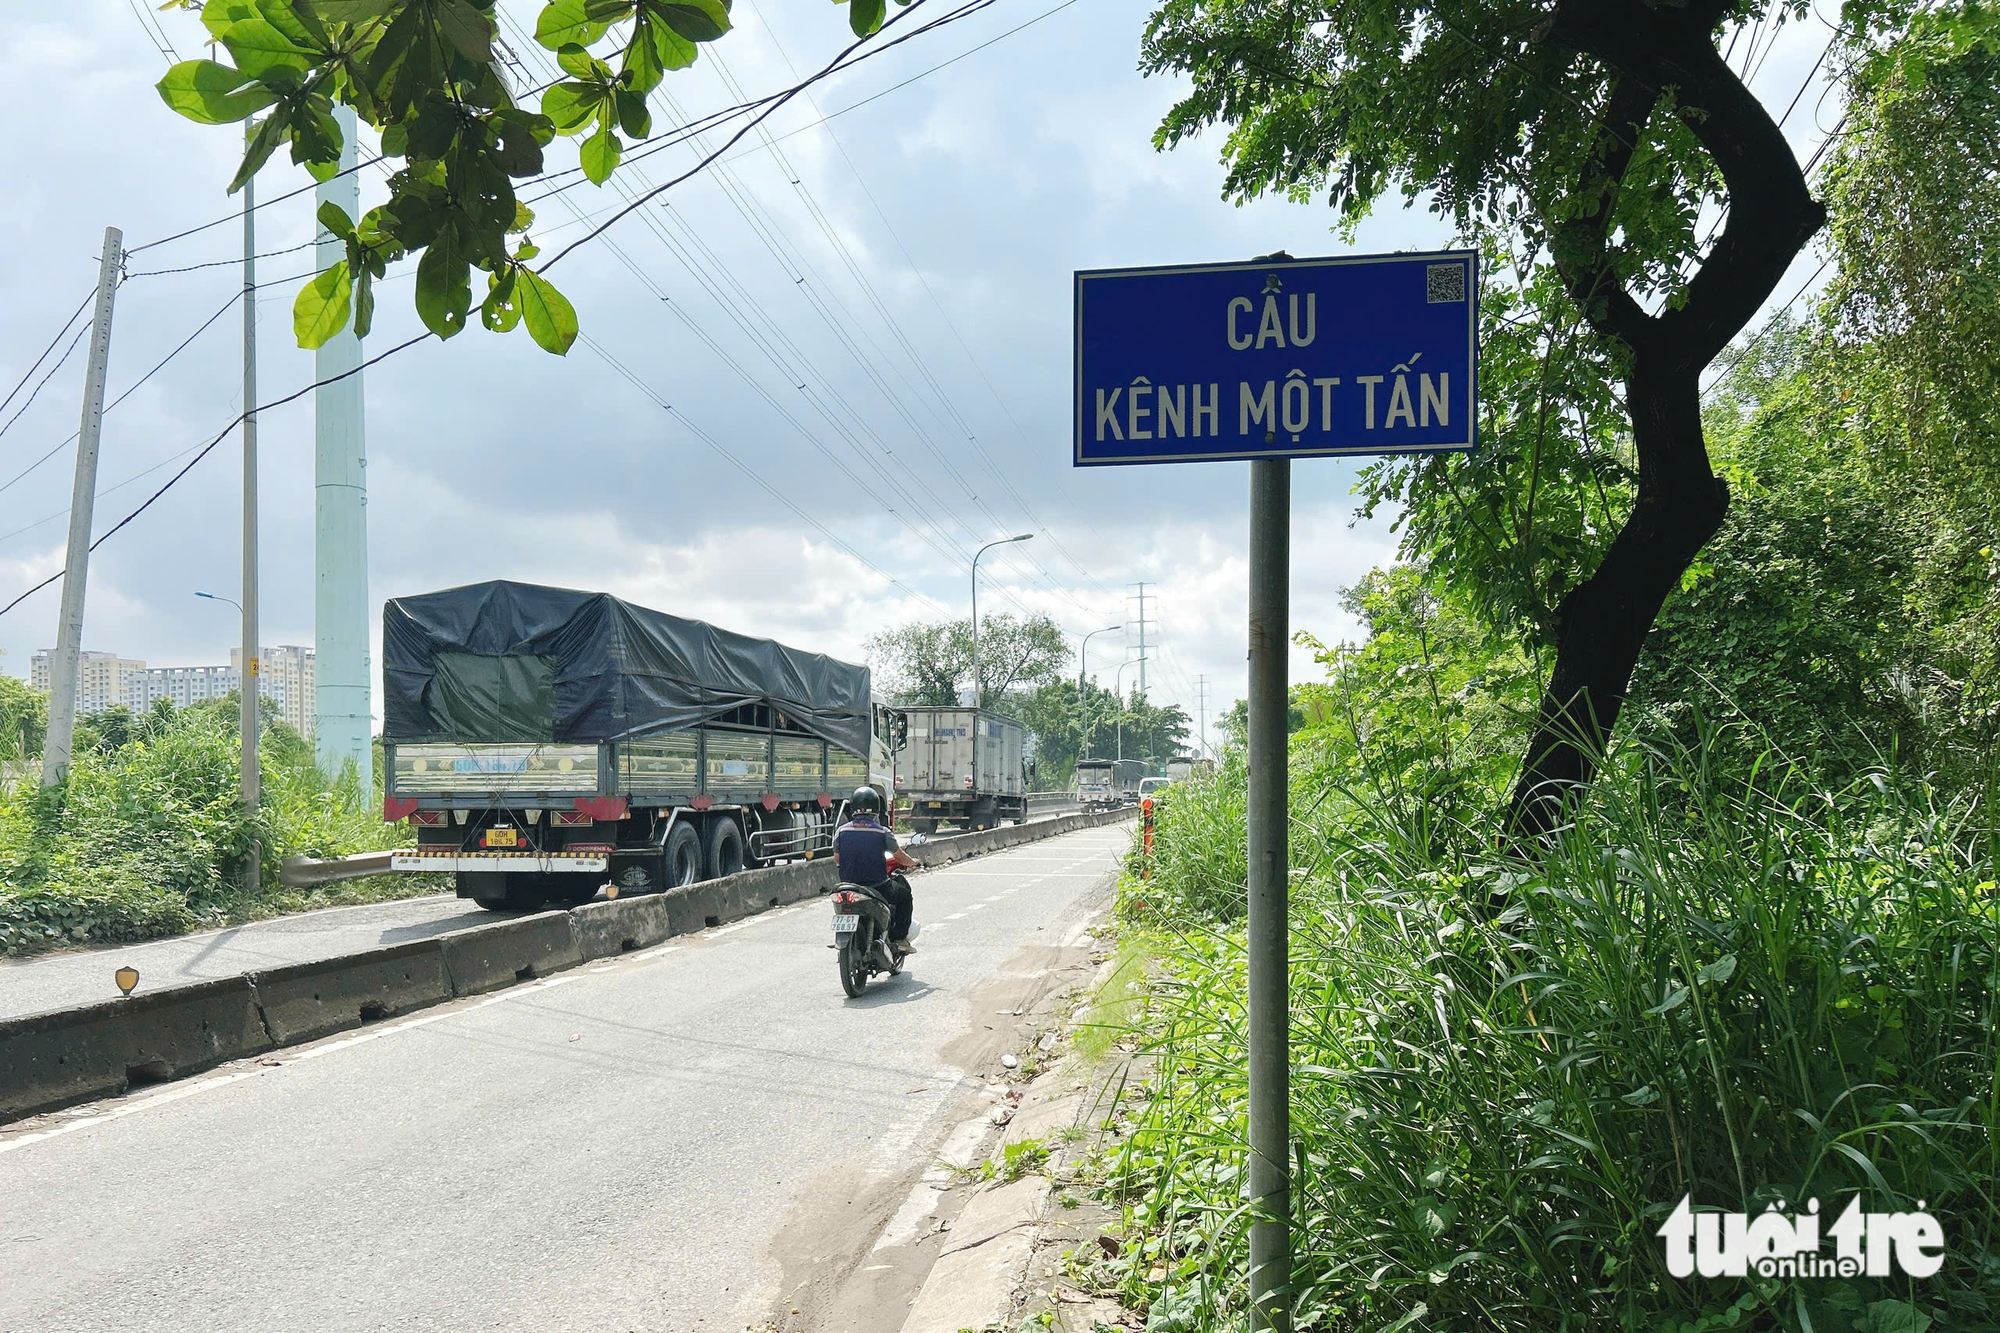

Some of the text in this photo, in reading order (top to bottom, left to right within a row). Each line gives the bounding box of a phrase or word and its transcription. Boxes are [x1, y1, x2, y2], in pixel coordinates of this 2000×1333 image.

[1227, 274, 1316, 350] CẦU
[1096, 352, 1449, 442] KÊNH MỘT TẤN
[494, 830, 508, 838] 60H
